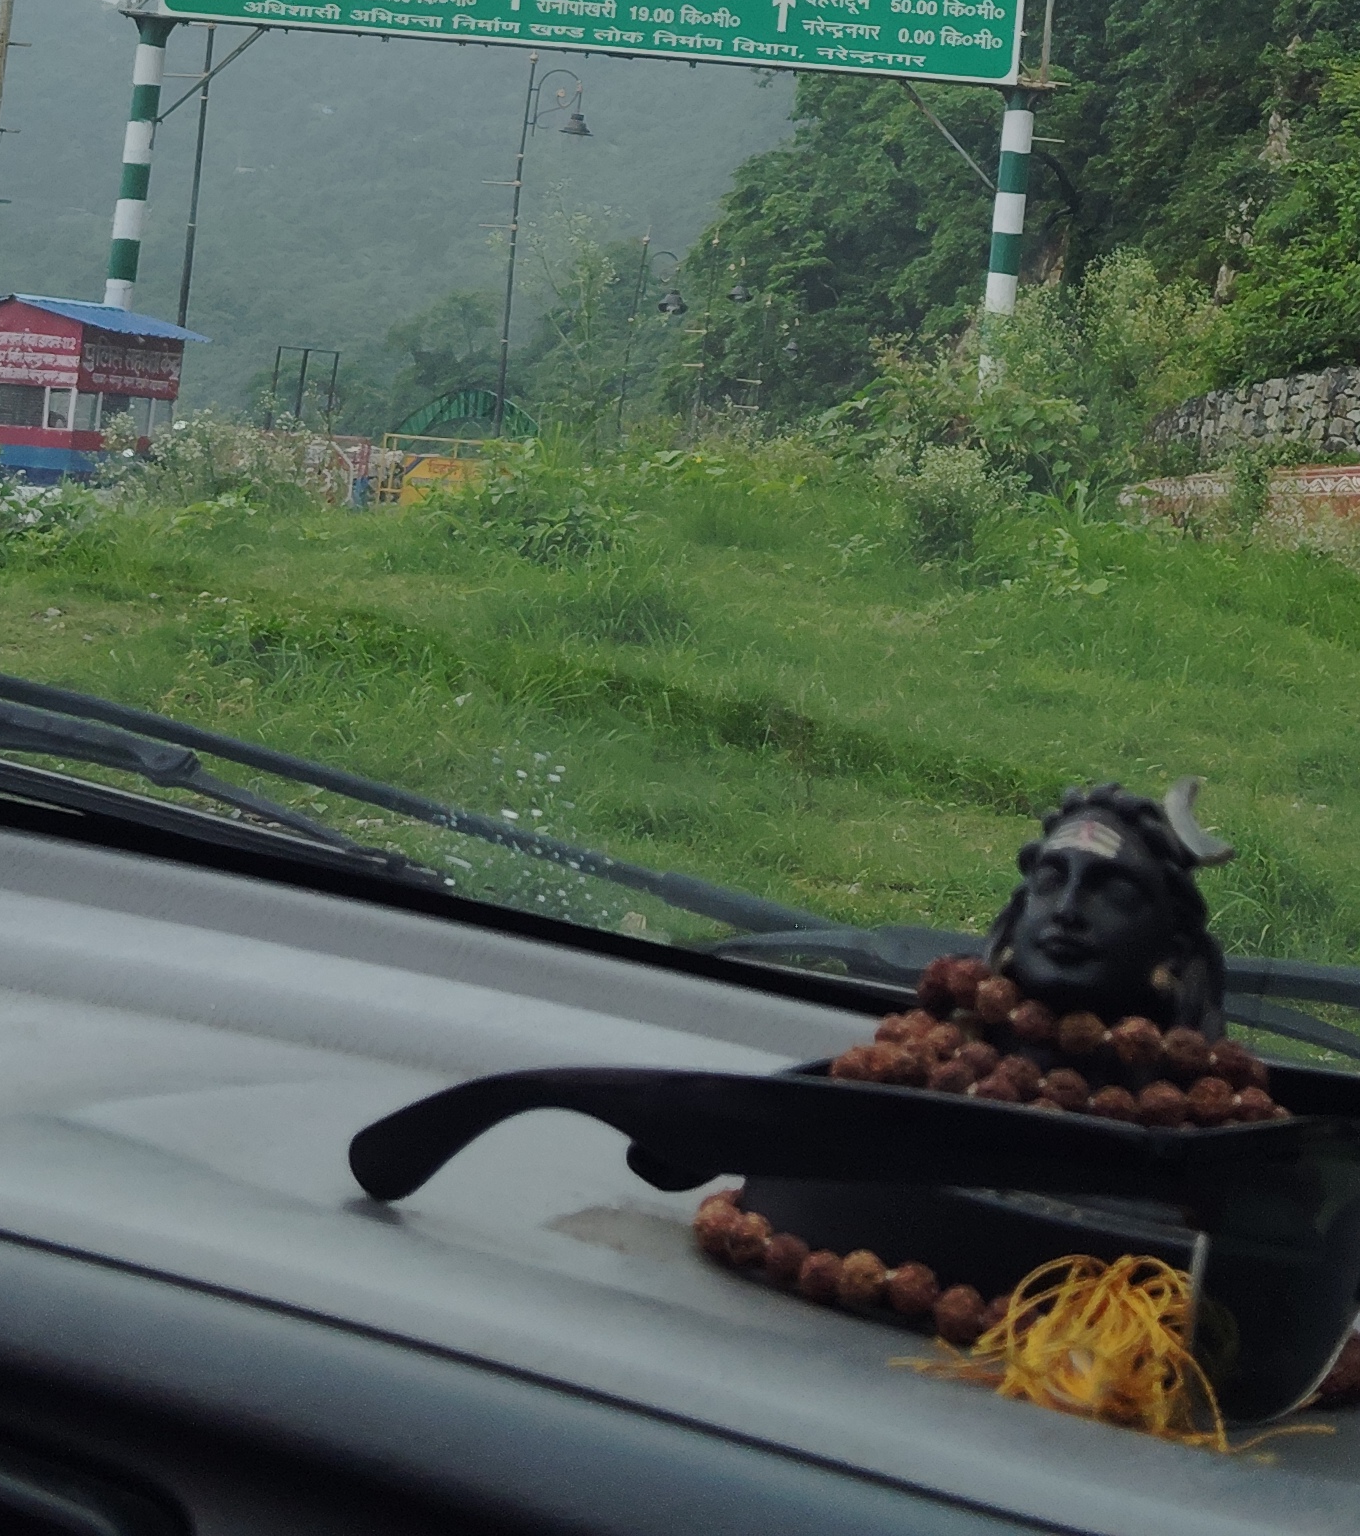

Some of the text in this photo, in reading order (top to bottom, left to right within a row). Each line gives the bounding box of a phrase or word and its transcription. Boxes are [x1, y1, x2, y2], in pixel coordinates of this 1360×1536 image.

[629, 5, 675, 24] 19.00
[242, 0, 342, 20] अधिशासी
[451, 14, 522, 35] निर्माण
[528, 24, 587, 39] खण्ड
[593, 26, 645, 43] लोक
[653, 30, 724, 51] निर्माण
[732, 36, 805, 59] विभाग,
[816, 44, 927, 68] नरेन्द्रनगर
[801, 15, 882, 41] नरेन्द्रनगर
[897, 27, 936, 45] 0.00
